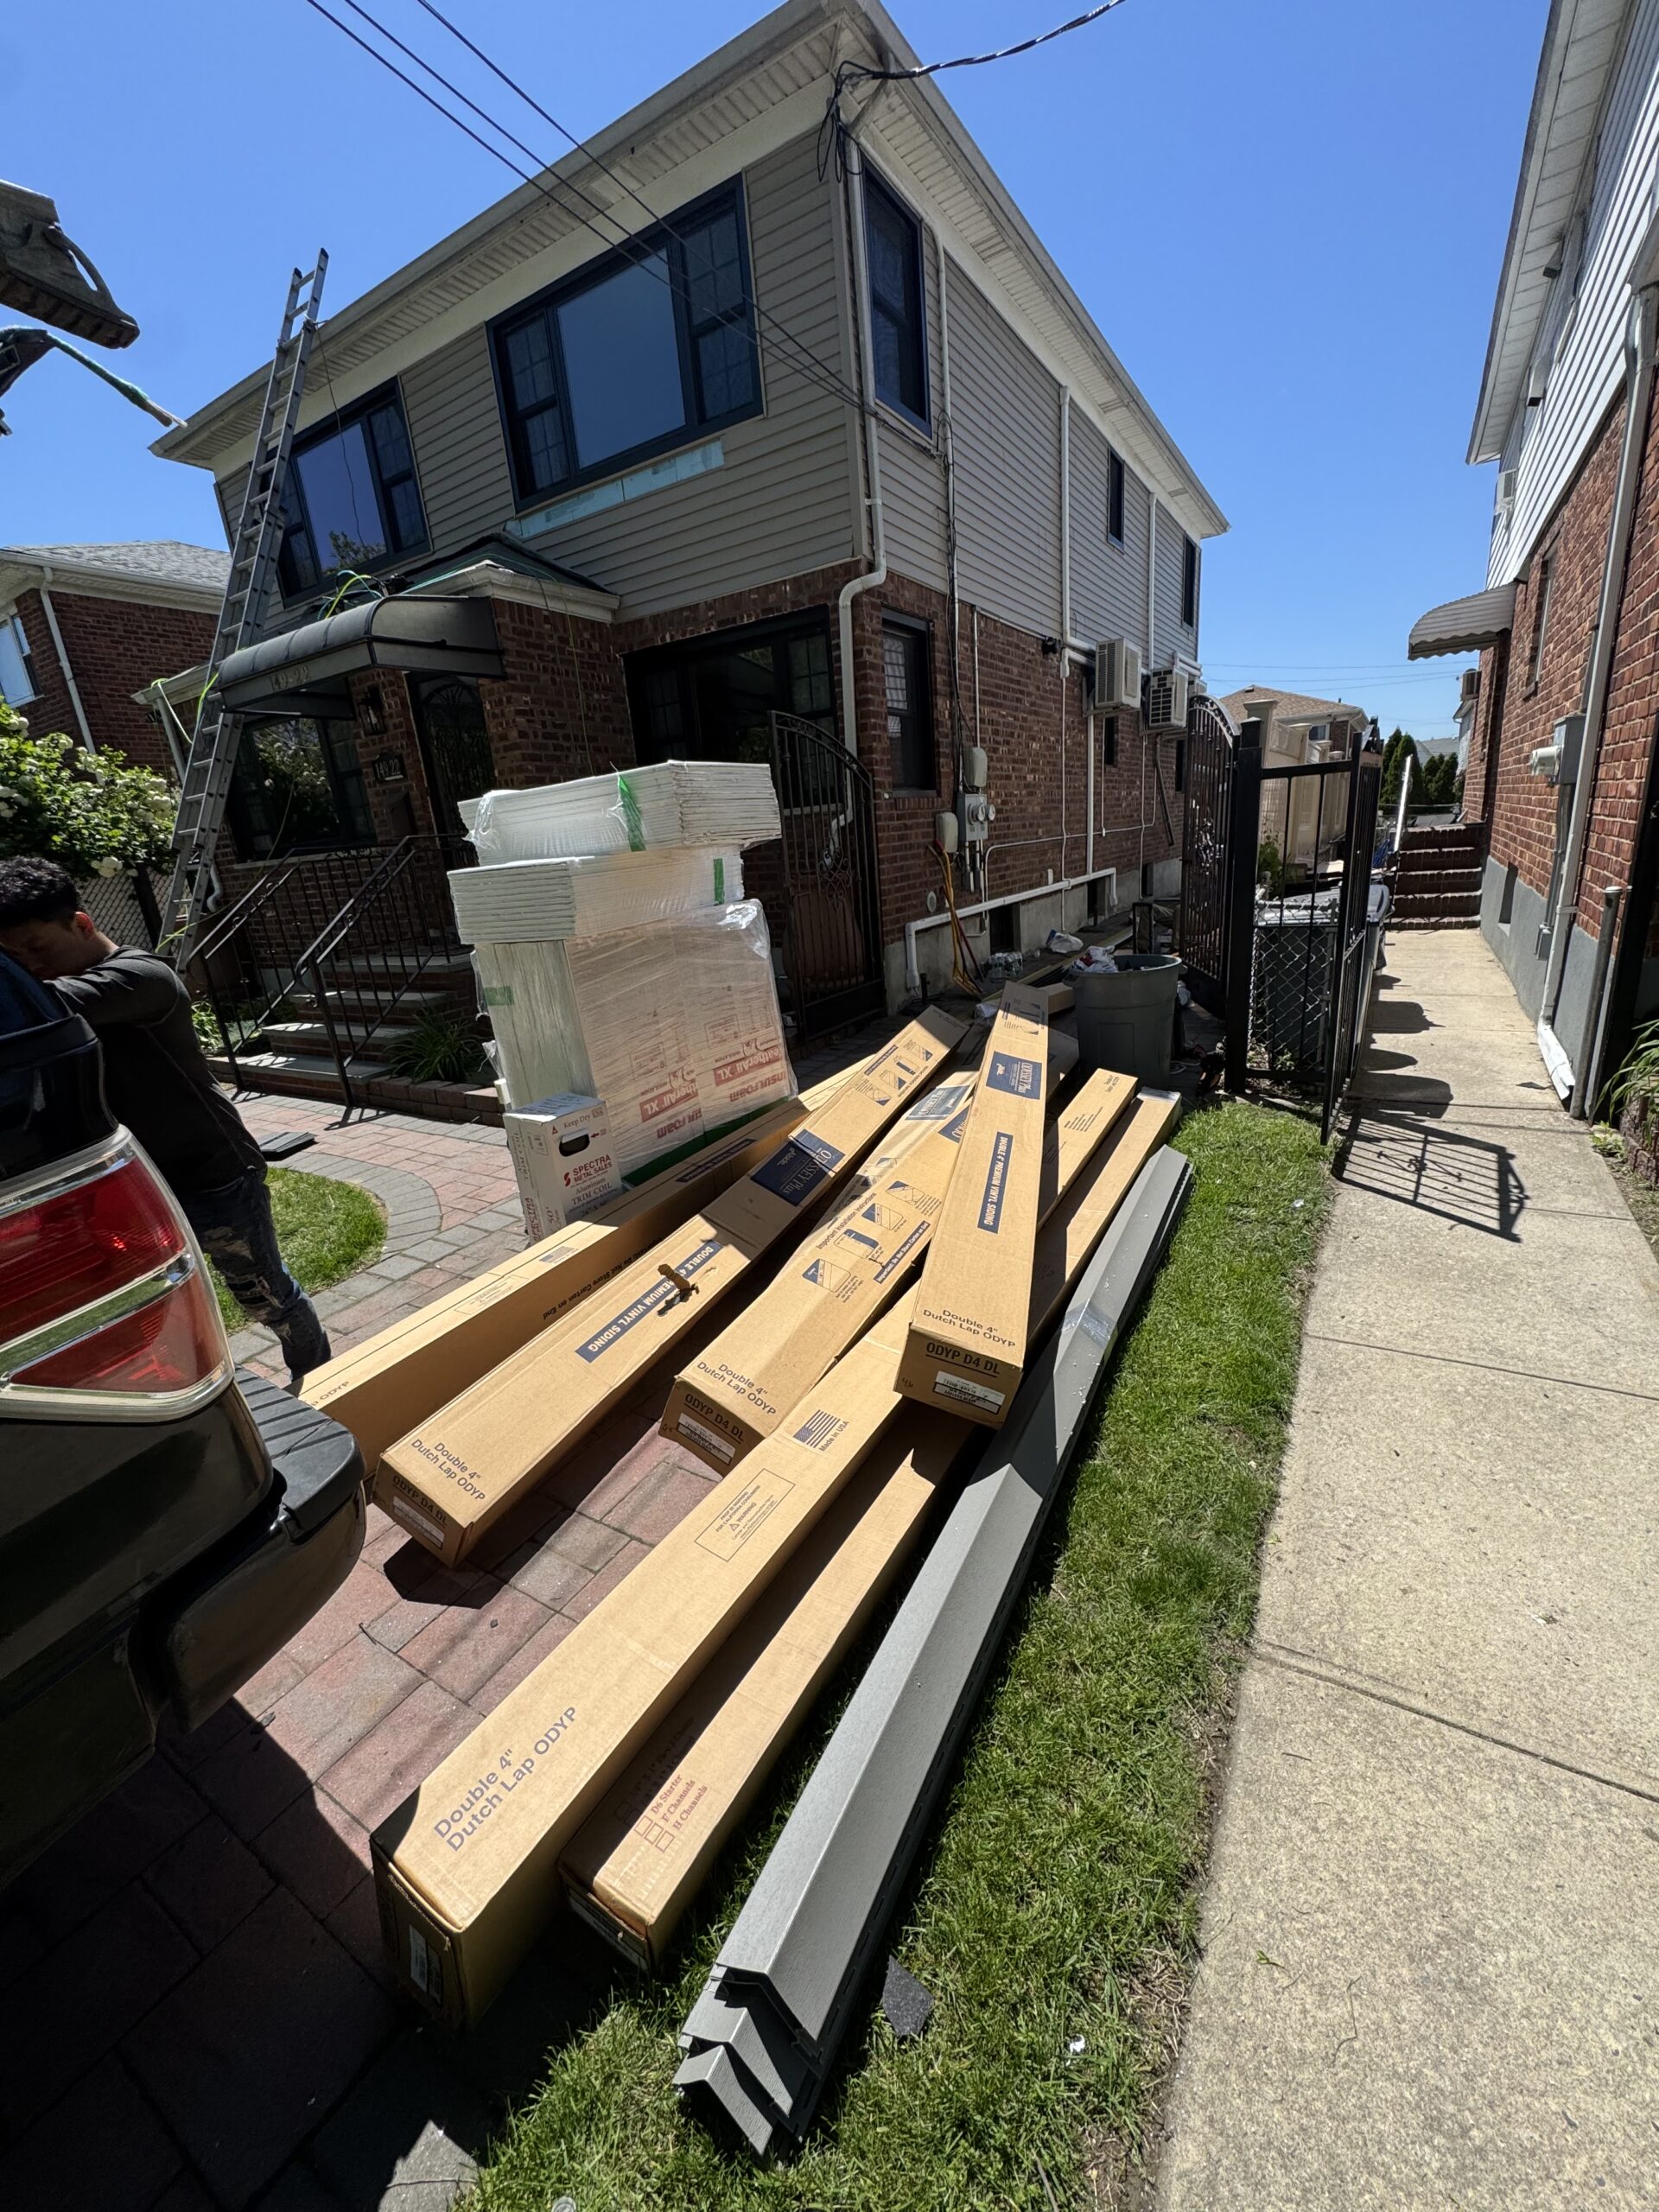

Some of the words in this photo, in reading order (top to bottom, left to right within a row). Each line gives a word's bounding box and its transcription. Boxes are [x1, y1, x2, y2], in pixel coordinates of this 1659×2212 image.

[717, 1065, 732, 1079] XL
[734, 1049, 782, 1074] eatherAll
[643, 1098, 659, 1115] XL
[563, 1117, 579, 1128] Keep
[579, 1113, 590, 1125] Dry
[573, 1154, 611, 1176] SPECTRA
[574, 1170, 594, 1183] METAL
[594, 1161, 613, 1174] SALES
[571, 1190, 592, 1205] TRIM
[594, 1182, 612, 1195] COIL
[983, 1203, 997, 1225] SIDING
[611, 1262, 623, 1275] Not
[685, 1246, 715, 1271] DOUBLE
[592, 1270, 610, 1287] Store
[558, 1299, 568, 1310] on
[569, 1284, 593, 1302] Carton
[642, 1279, 675, 1308] REMIUM
[543, 1305, 558, 1320] End
[618, 1305, 648, 1326] VINYL
[943, 1309, 984, 1330] Double
[588, 1325, 622, 1353] SIDING
[923, 1309, 957, 1327] Dutch
[959, 1323, 980, 1336] Lap
[983, 1332, 1016, 1348] ODYP
[926, 1342, 961, 1360] ODYP
[963, 1354, 981, 1367] D4
[984, 1360, 1000, 1375] DL
[696, 1361, 726, 1382] Dutch
[727, 1379, 746, 1395] Lap
[747, 1392, 777, 1415] ODYP
[718, 1363, 754, 1389] Double
[320, 1381, 349, 1401] ODYP
[684, 1393, 714, 1415] ODYP
[715, 1414, 729, 1429] D4
[731, 1425, 745, 1440] DL
[818, 1437, 835, 1452] Made
[836, 1421, 850, 1433] USA
[410, 1439, 440, 1465] Dutch
[438, 1461, 456, 1479] Lap
[457, 1477, 486, 1501] ODYP
[434, 1442, 468, 1473] Double
[468, 1471, 481, 1480] 4"
[392, 1475, 419, 1499] ODYP
[435, 1510, 448, 1524] DL
[736, 1502, 757, 1522] WARNING
[446, 1794, 504, 1852] Dutch
[499, 1758, 535, 1793] Lap
[534, 1707, 577, 1755] ODYP
[434, 1772, 499, 1839] Double
[499, 1748, 513, 1770] 4"
[651, 1801, 663, 1815] D6
[659, 1775, 683, 1802] Starter
[667, 1779, 696, 1815] Channels
[680, 1785, 708, 1821] Channels
